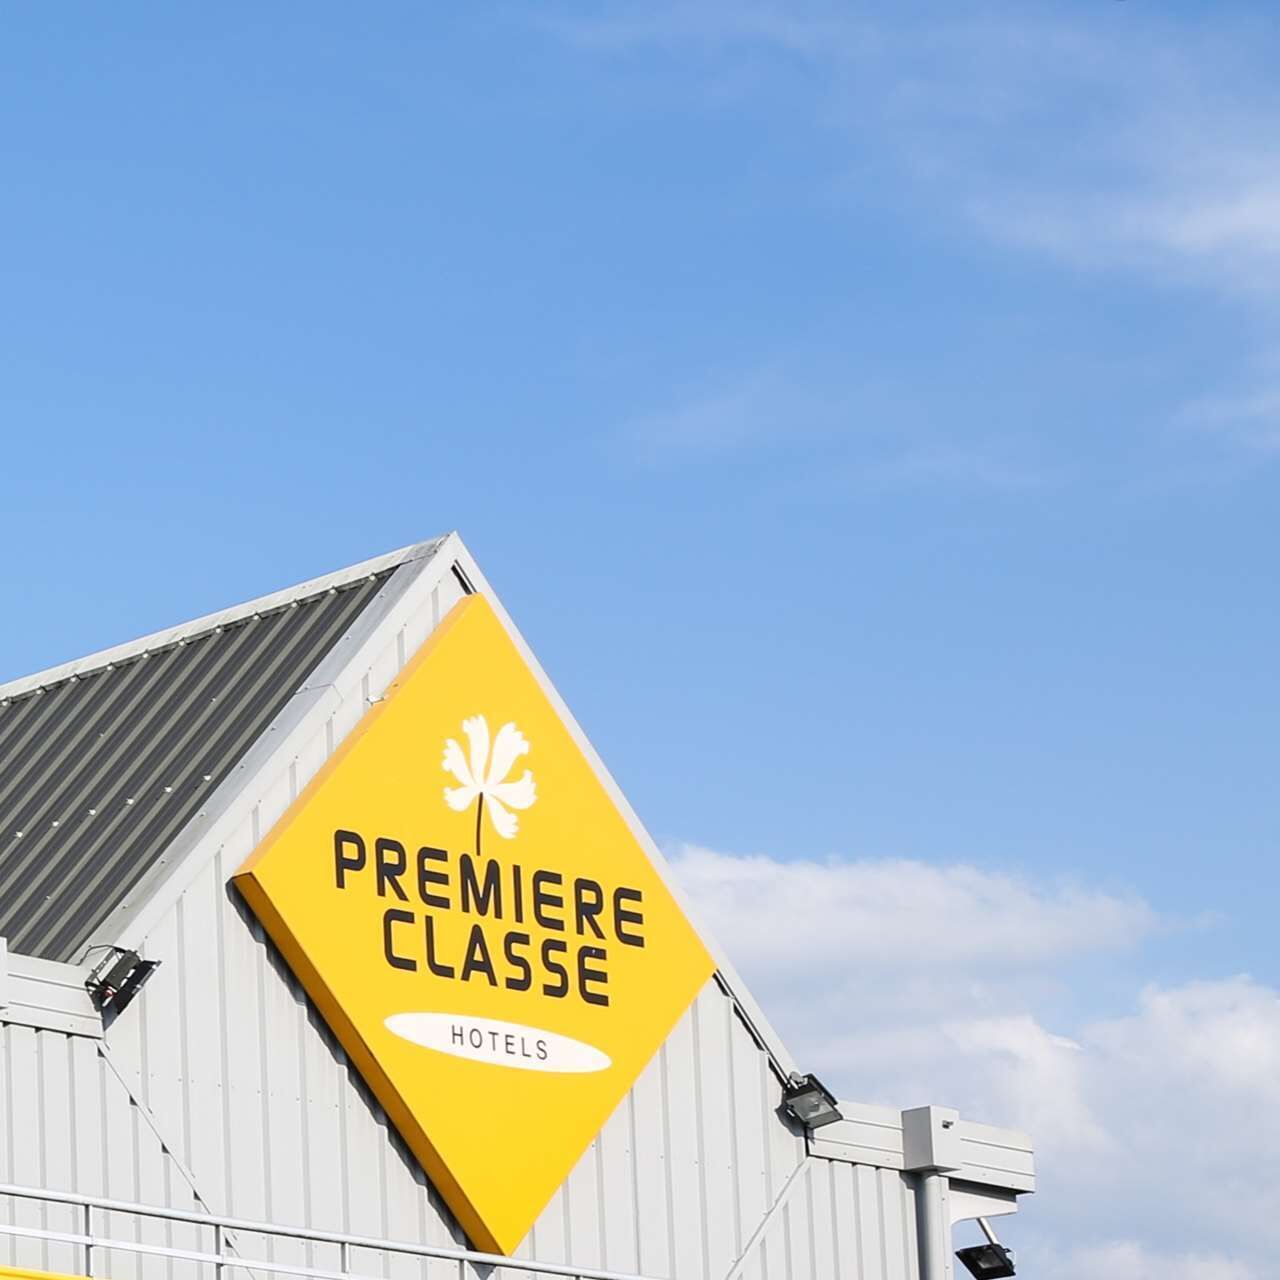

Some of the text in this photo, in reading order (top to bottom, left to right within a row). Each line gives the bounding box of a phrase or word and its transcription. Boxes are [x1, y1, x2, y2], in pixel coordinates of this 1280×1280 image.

[333, 828, 645, 948] PREMIERE
[383, 908, 610, 1007] CLASSE
[450, 1024, 548, 1061] HOTELS
